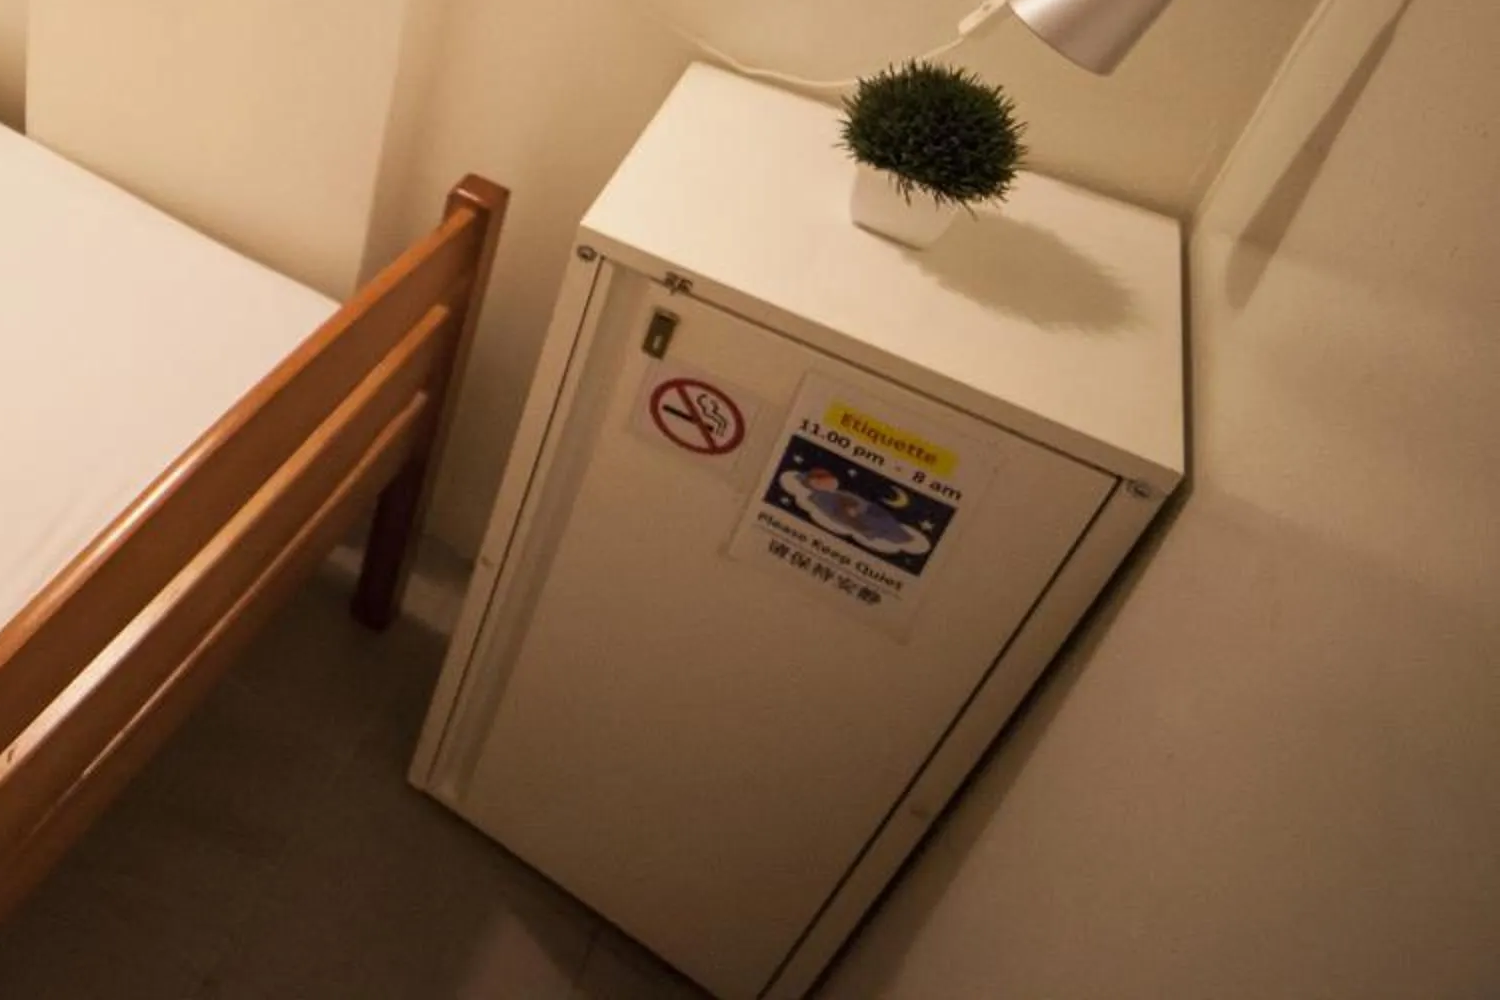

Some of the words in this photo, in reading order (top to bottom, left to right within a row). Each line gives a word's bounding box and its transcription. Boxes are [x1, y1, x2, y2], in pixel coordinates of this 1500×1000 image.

[799, 419, 850, 449] 11.00
[852, 446, 885, 466] pm
[911, 470, 927, 484] 8
[929, 479, 963, 501] am
[839, 412, 937, 465] Etiquette
[757, 511, 808, 542] Please
[811, 538, 851, 566] Keep
[855, 561, 904, 591] Quiet
